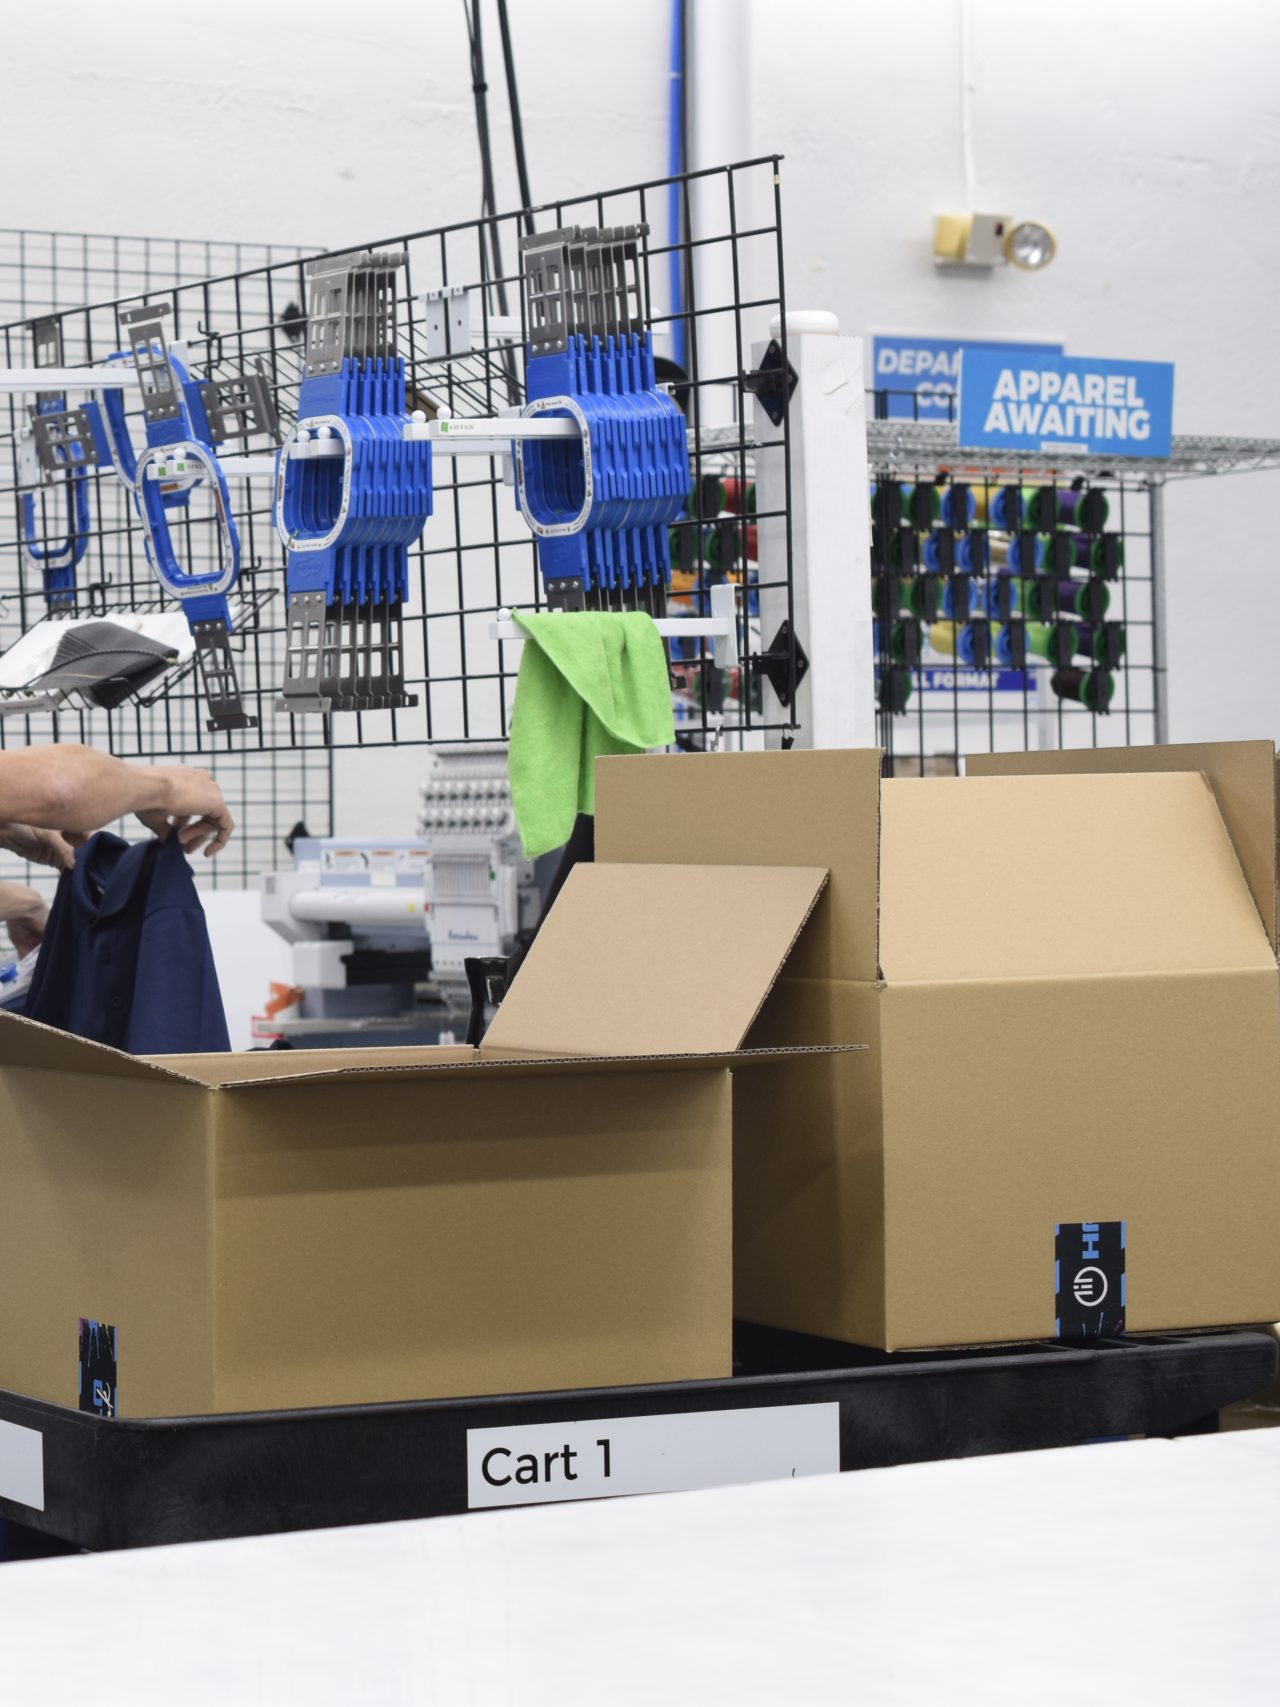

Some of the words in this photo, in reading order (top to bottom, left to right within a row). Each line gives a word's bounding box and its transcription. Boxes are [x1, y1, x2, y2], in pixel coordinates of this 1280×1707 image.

[916, 381, 957, 408] CO
[993, 369, 1144, 408] APPAREL
[984, 402, 1150, 440] AWAITING
[933, 671, 1000, 689] FORMAT
[482, 1444, 577, 1486] Cart
[597, 1439, 610, 1477] 1
